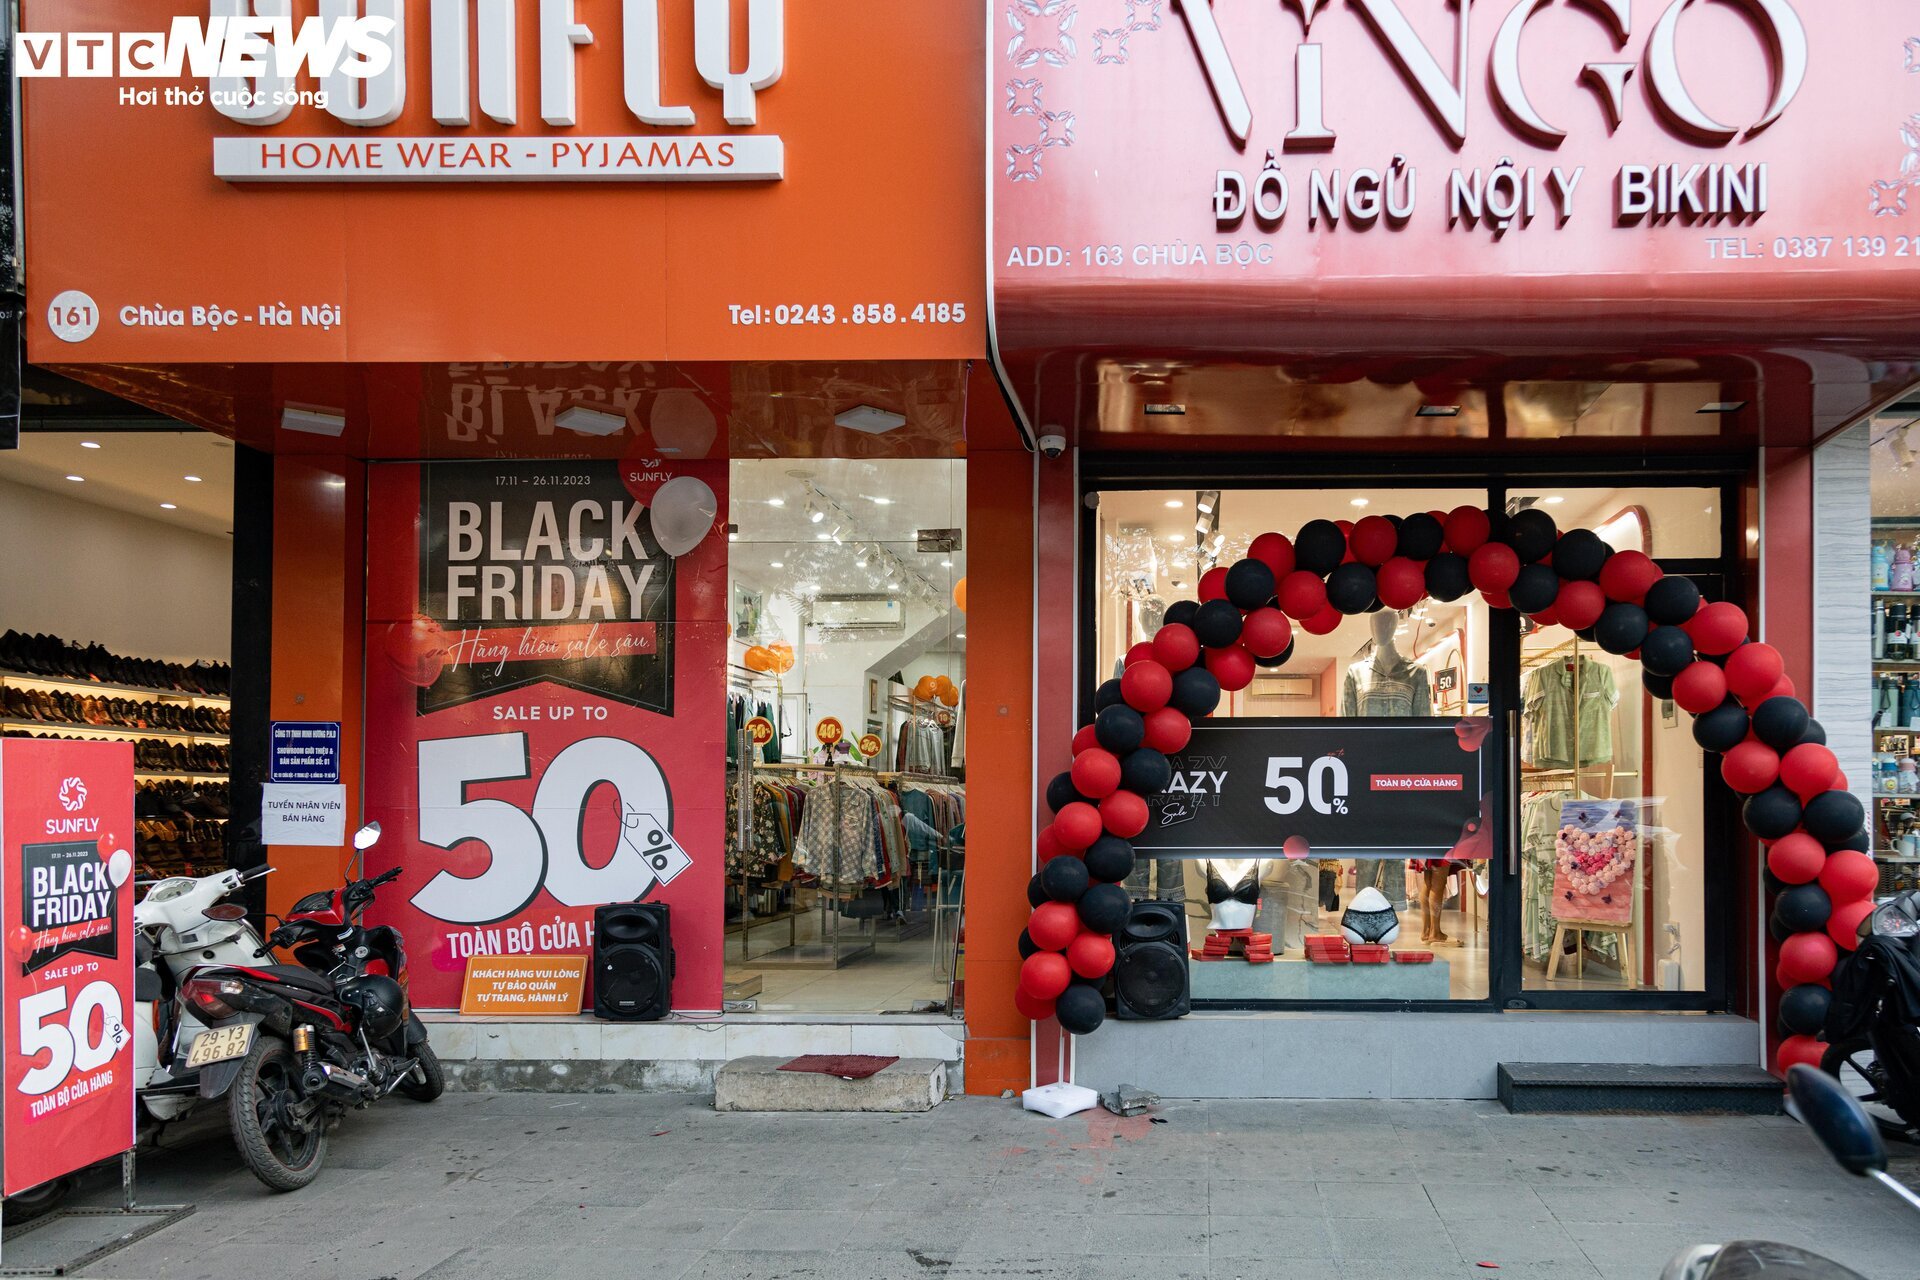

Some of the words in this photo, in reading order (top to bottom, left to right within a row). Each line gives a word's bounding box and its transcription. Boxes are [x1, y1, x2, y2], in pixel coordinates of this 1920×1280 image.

[262, 143, 383, 169] HOME
[397, 142, 512, 168] WEAR
[552, 142, 735, 168] PYJAMAS
[1213, 149, 1289, 224] ĐỒ
[1309, 153, 1416, 222] NGỦ
[1451, 156, 1536, 230] NỘI
[1550, 165, 1585, 218] Y
[1620, 163, 1768, 218] BIKINI
[1006, 245, 1071, 267] ADD:
[1081, 245, 1124, 266] 163
[1216, 240, 1273, 270] BỘC
[1705, 237, 1764, 259] TEL:
[1773, 237, 1834, 259] 0387
[1842, 236, 1887, 258] 139
[53, 307, 92, 326] 161
[120, 303, 184, 326] Chùa
[192, 304, 238, 331] Bộc
[259, 301, 292, 326] Hà
[301, 303, 341, 331] Nội
[495, 476, 518, 486] 17.11
[533, 475, 591, 486] 26.11.2023
[629, 472, 672, 483] SUNFLY
[448, 500, 649, 561] BLACK
[447, 564, 656, 621] FRIDAY
[448, 626, 511, 676] Hàng
[518, 627, 560, 657] hiệu
[562, 623, 608, 661] sale
[611, 634, 650, 658] sâu
[493, 706, 541, 720] SALE
[549, 706, 574, 720] UP
[582, 706, 608, 720] TO
[1376, 778, 1398, 787] TOÀN
[1400, 778, 1412, 788] BỘ
[1433, 778, 1458, 787] HÀNG
[46, 817, 100, 835] SUNFLY
[33, 862, 109, 898] BLACK
[33, 891, 112, 928] FRIDAY
[446, 926, 502, 959] TOÀN
[507, 922, 534, 956] BỘ
[540, 916, 581, 951] CỬA
[44, 968, 68, 981] SALE
[71, 965, 84, 975] UP
[87, 963, 99, 972] TO
[472, 968, 505, 979] KHÁCH
[507, 968, 534, 979] HÀNG
[536, 970, 552, 979] VUI
[554, 968, 580, 979] LÒNG
[477, 994, 492, 1002] TƯ
[492, 994, 526, 1004] TRANG,
[528, 993, 556, 1002] HÀNH
[558, 992, 569, 1002] LÝ
[493, 981, 506, 993] TỰ
[507, 981, 528, 991] BẢO
[529, 981, 557, 992] QUẢN
[201, 1026, 244, 1047] 29-Y3
[192, 1041, 245, 1063] 496.82
[30, 1095, 56, 1118] TOÀN
[57, 1086, 71, 1106] BỘ
[71, 1079, 89, 1100] CỬA
[90, 1070, 113, 1093] HÀNG
